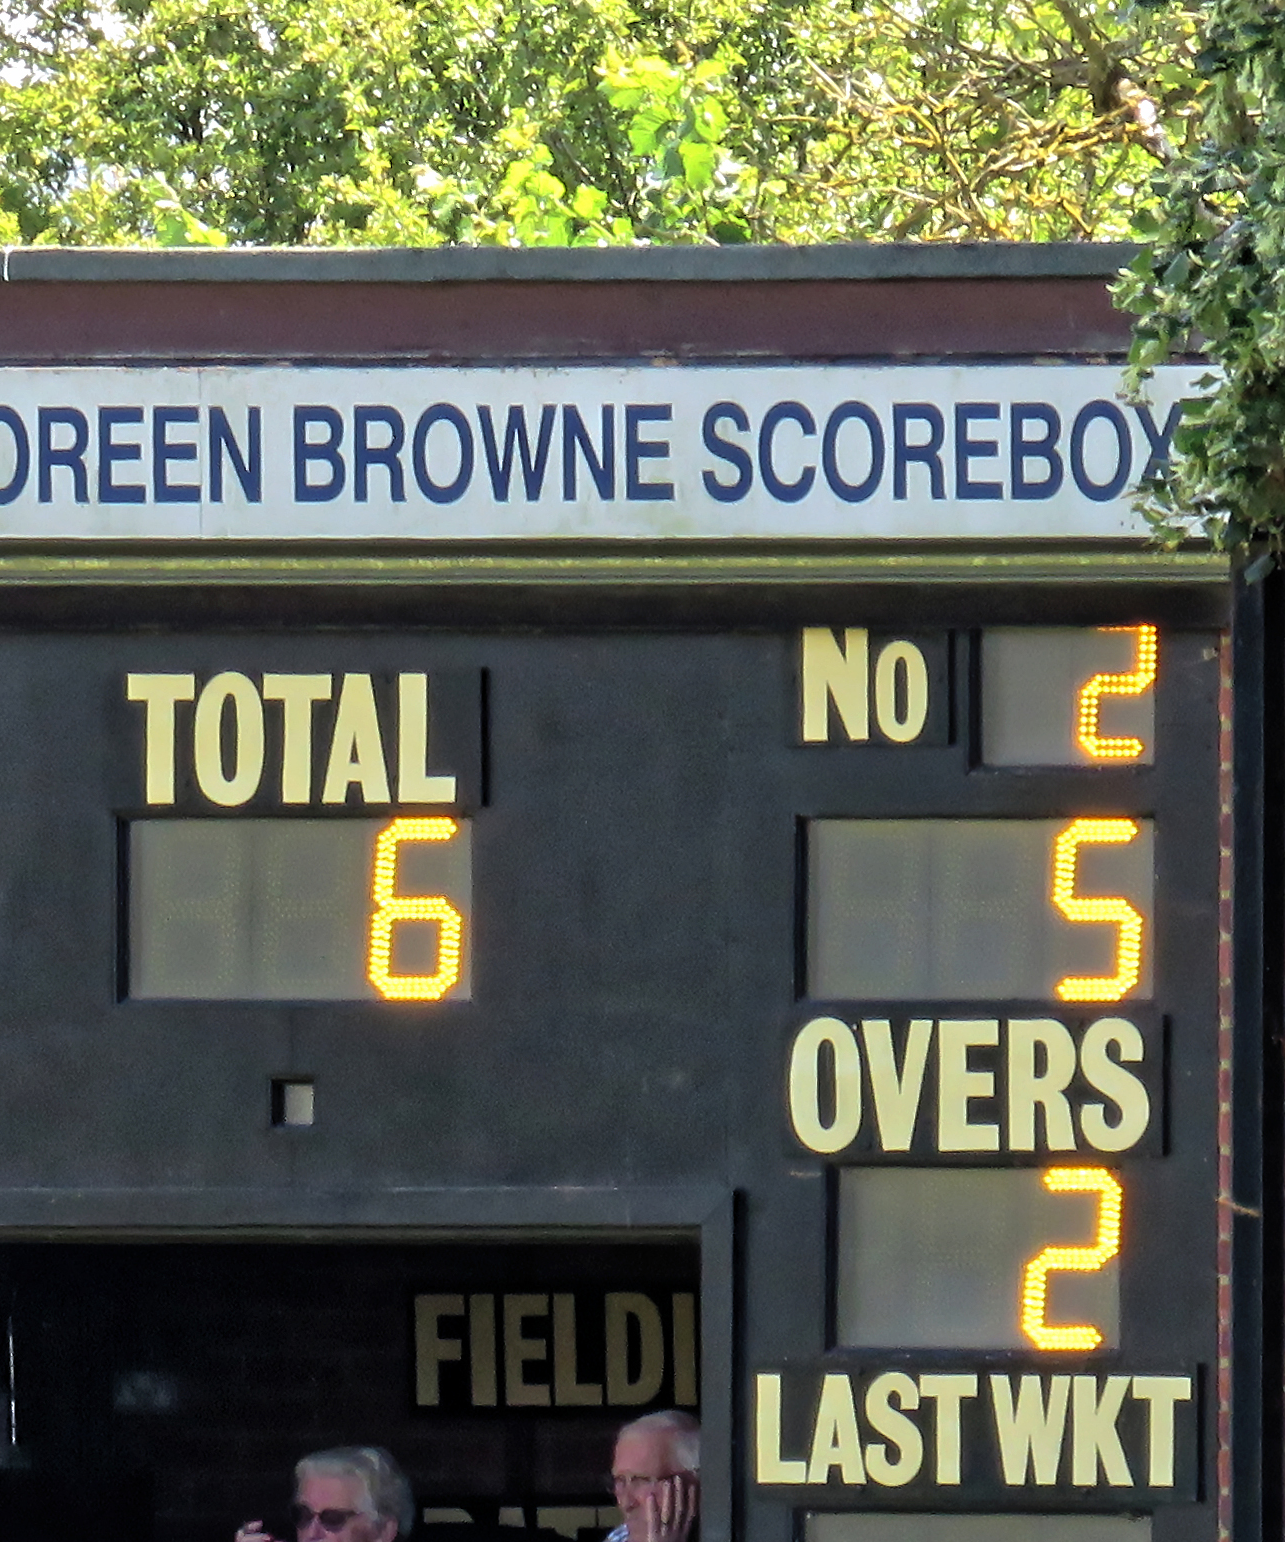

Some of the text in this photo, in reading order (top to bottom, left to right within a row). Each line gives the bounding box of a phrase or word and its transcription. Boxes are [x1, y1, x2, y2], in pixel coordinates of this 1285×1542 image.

[294, 404, 674, 503] BROWNE
[128, 672, 455, 806] TOTAL
[1077, 625, 1156, 758] 2
[366, 817, 464, 1001] 6
[1050, 818, 1145, 1001] 5
[790, 1018, 1149, 1152] OVERS
[1018, 1166, 1122, 1351] 2
[757, 1372, 1191, 1486] LAST WKT
